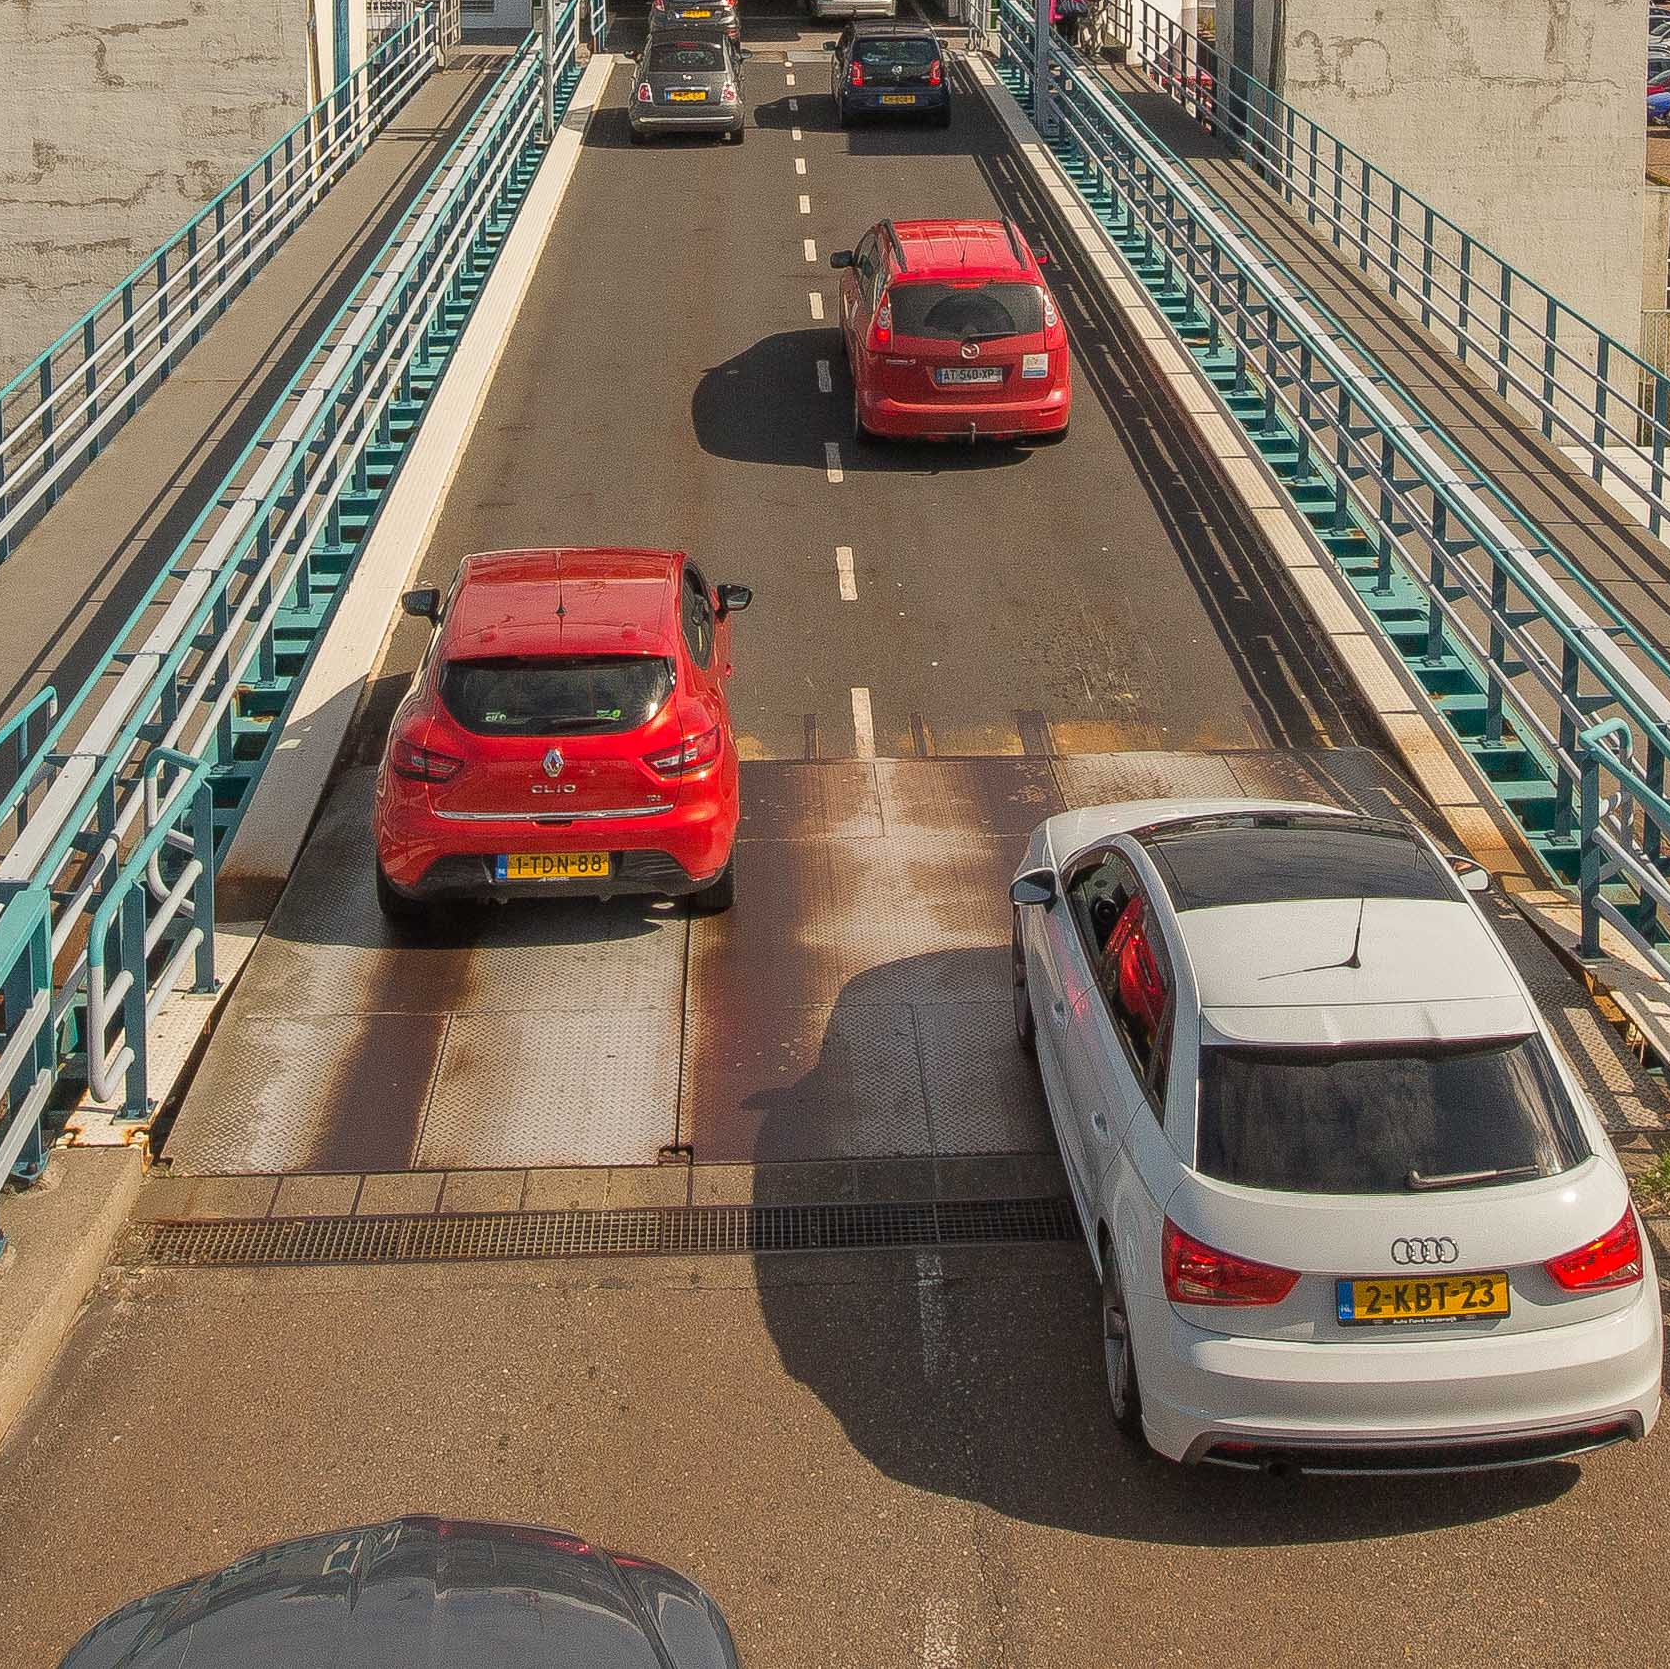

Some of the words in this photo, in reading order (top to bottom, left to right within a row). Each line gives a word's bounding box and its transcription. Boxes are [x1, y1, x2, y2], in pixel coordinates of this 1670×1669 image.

[531, 784, 576, 794] CLIO
[516, 854, 603, 875] 1-TDN-88
[1365, 1280, 1496, 1315] 2-KBT-23
